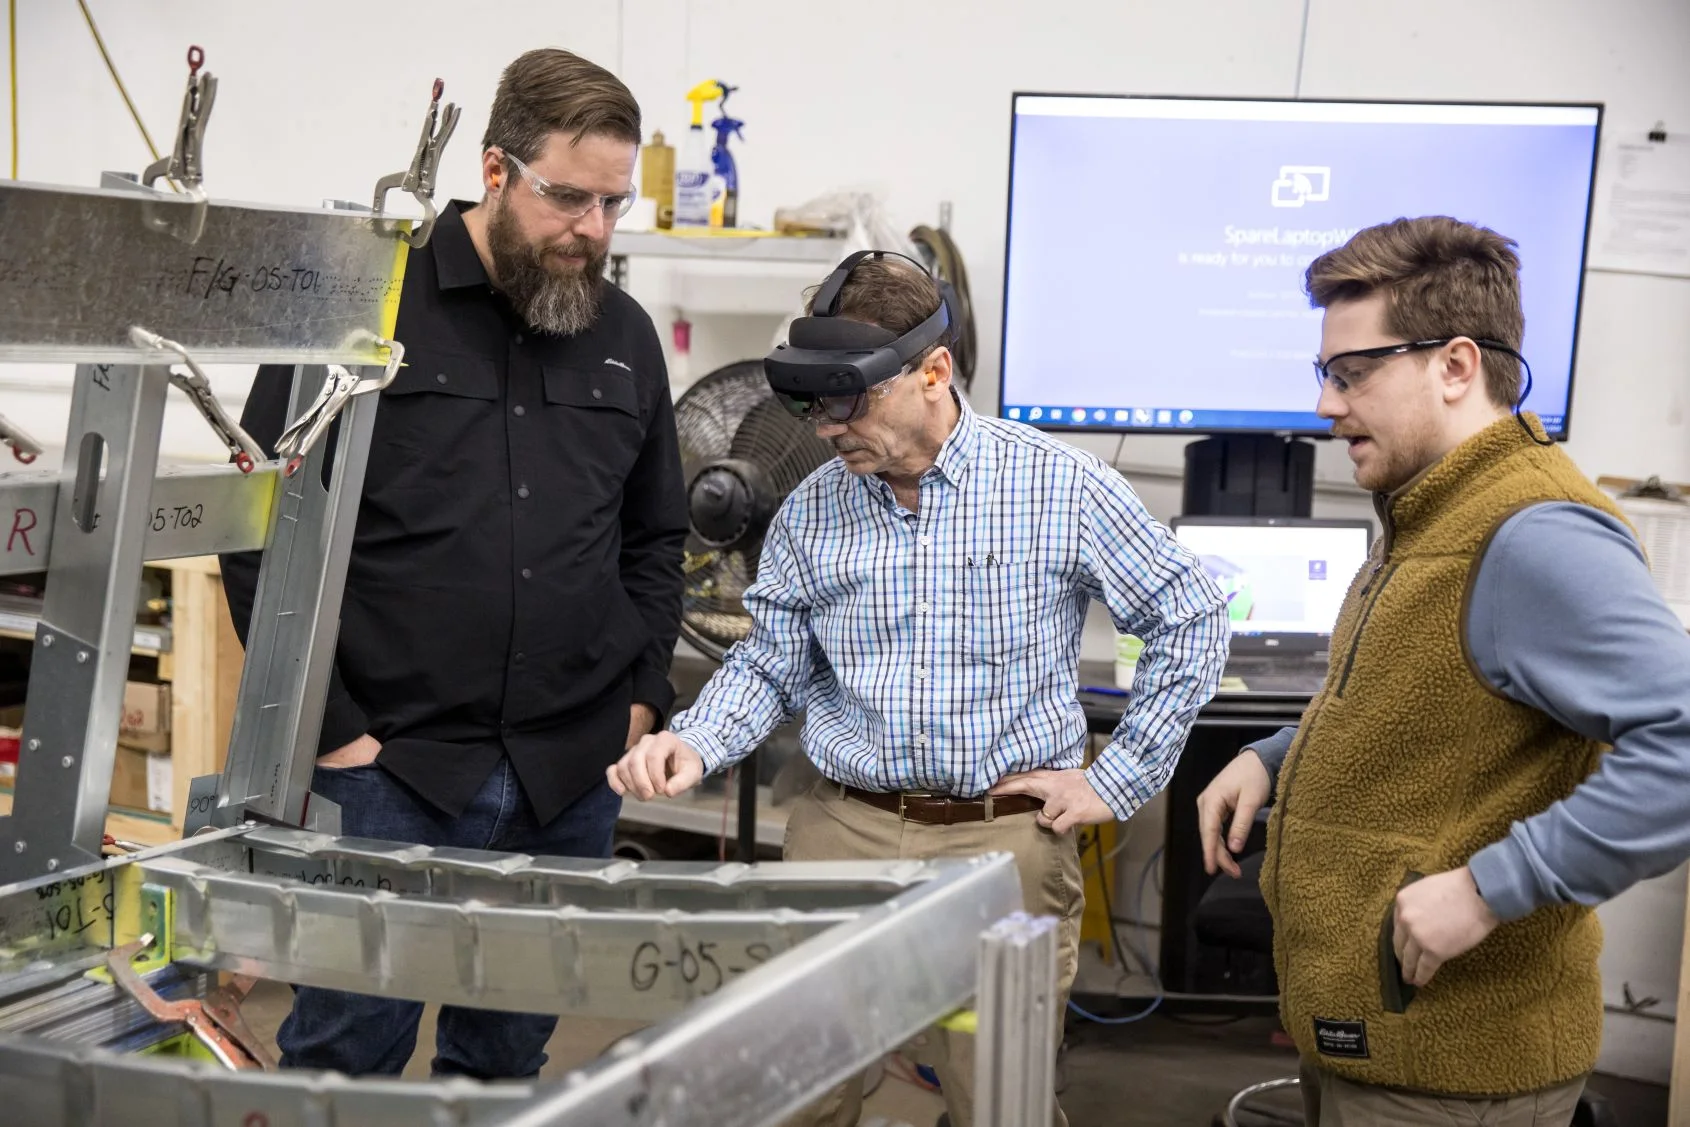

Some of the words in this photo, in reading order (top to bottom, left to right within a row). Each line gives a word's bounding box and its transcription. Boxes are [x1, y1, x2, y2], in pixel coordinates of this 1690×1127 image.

[1192, 252, 1227, 268] ready
[1231, 252, 1249, 266] for
[1252, 255, 1277, 268] you
[1280, 253, 1294, 267] to
[7, 508, 37, 556] R
[148, 503, 203, 532] 5-T02
